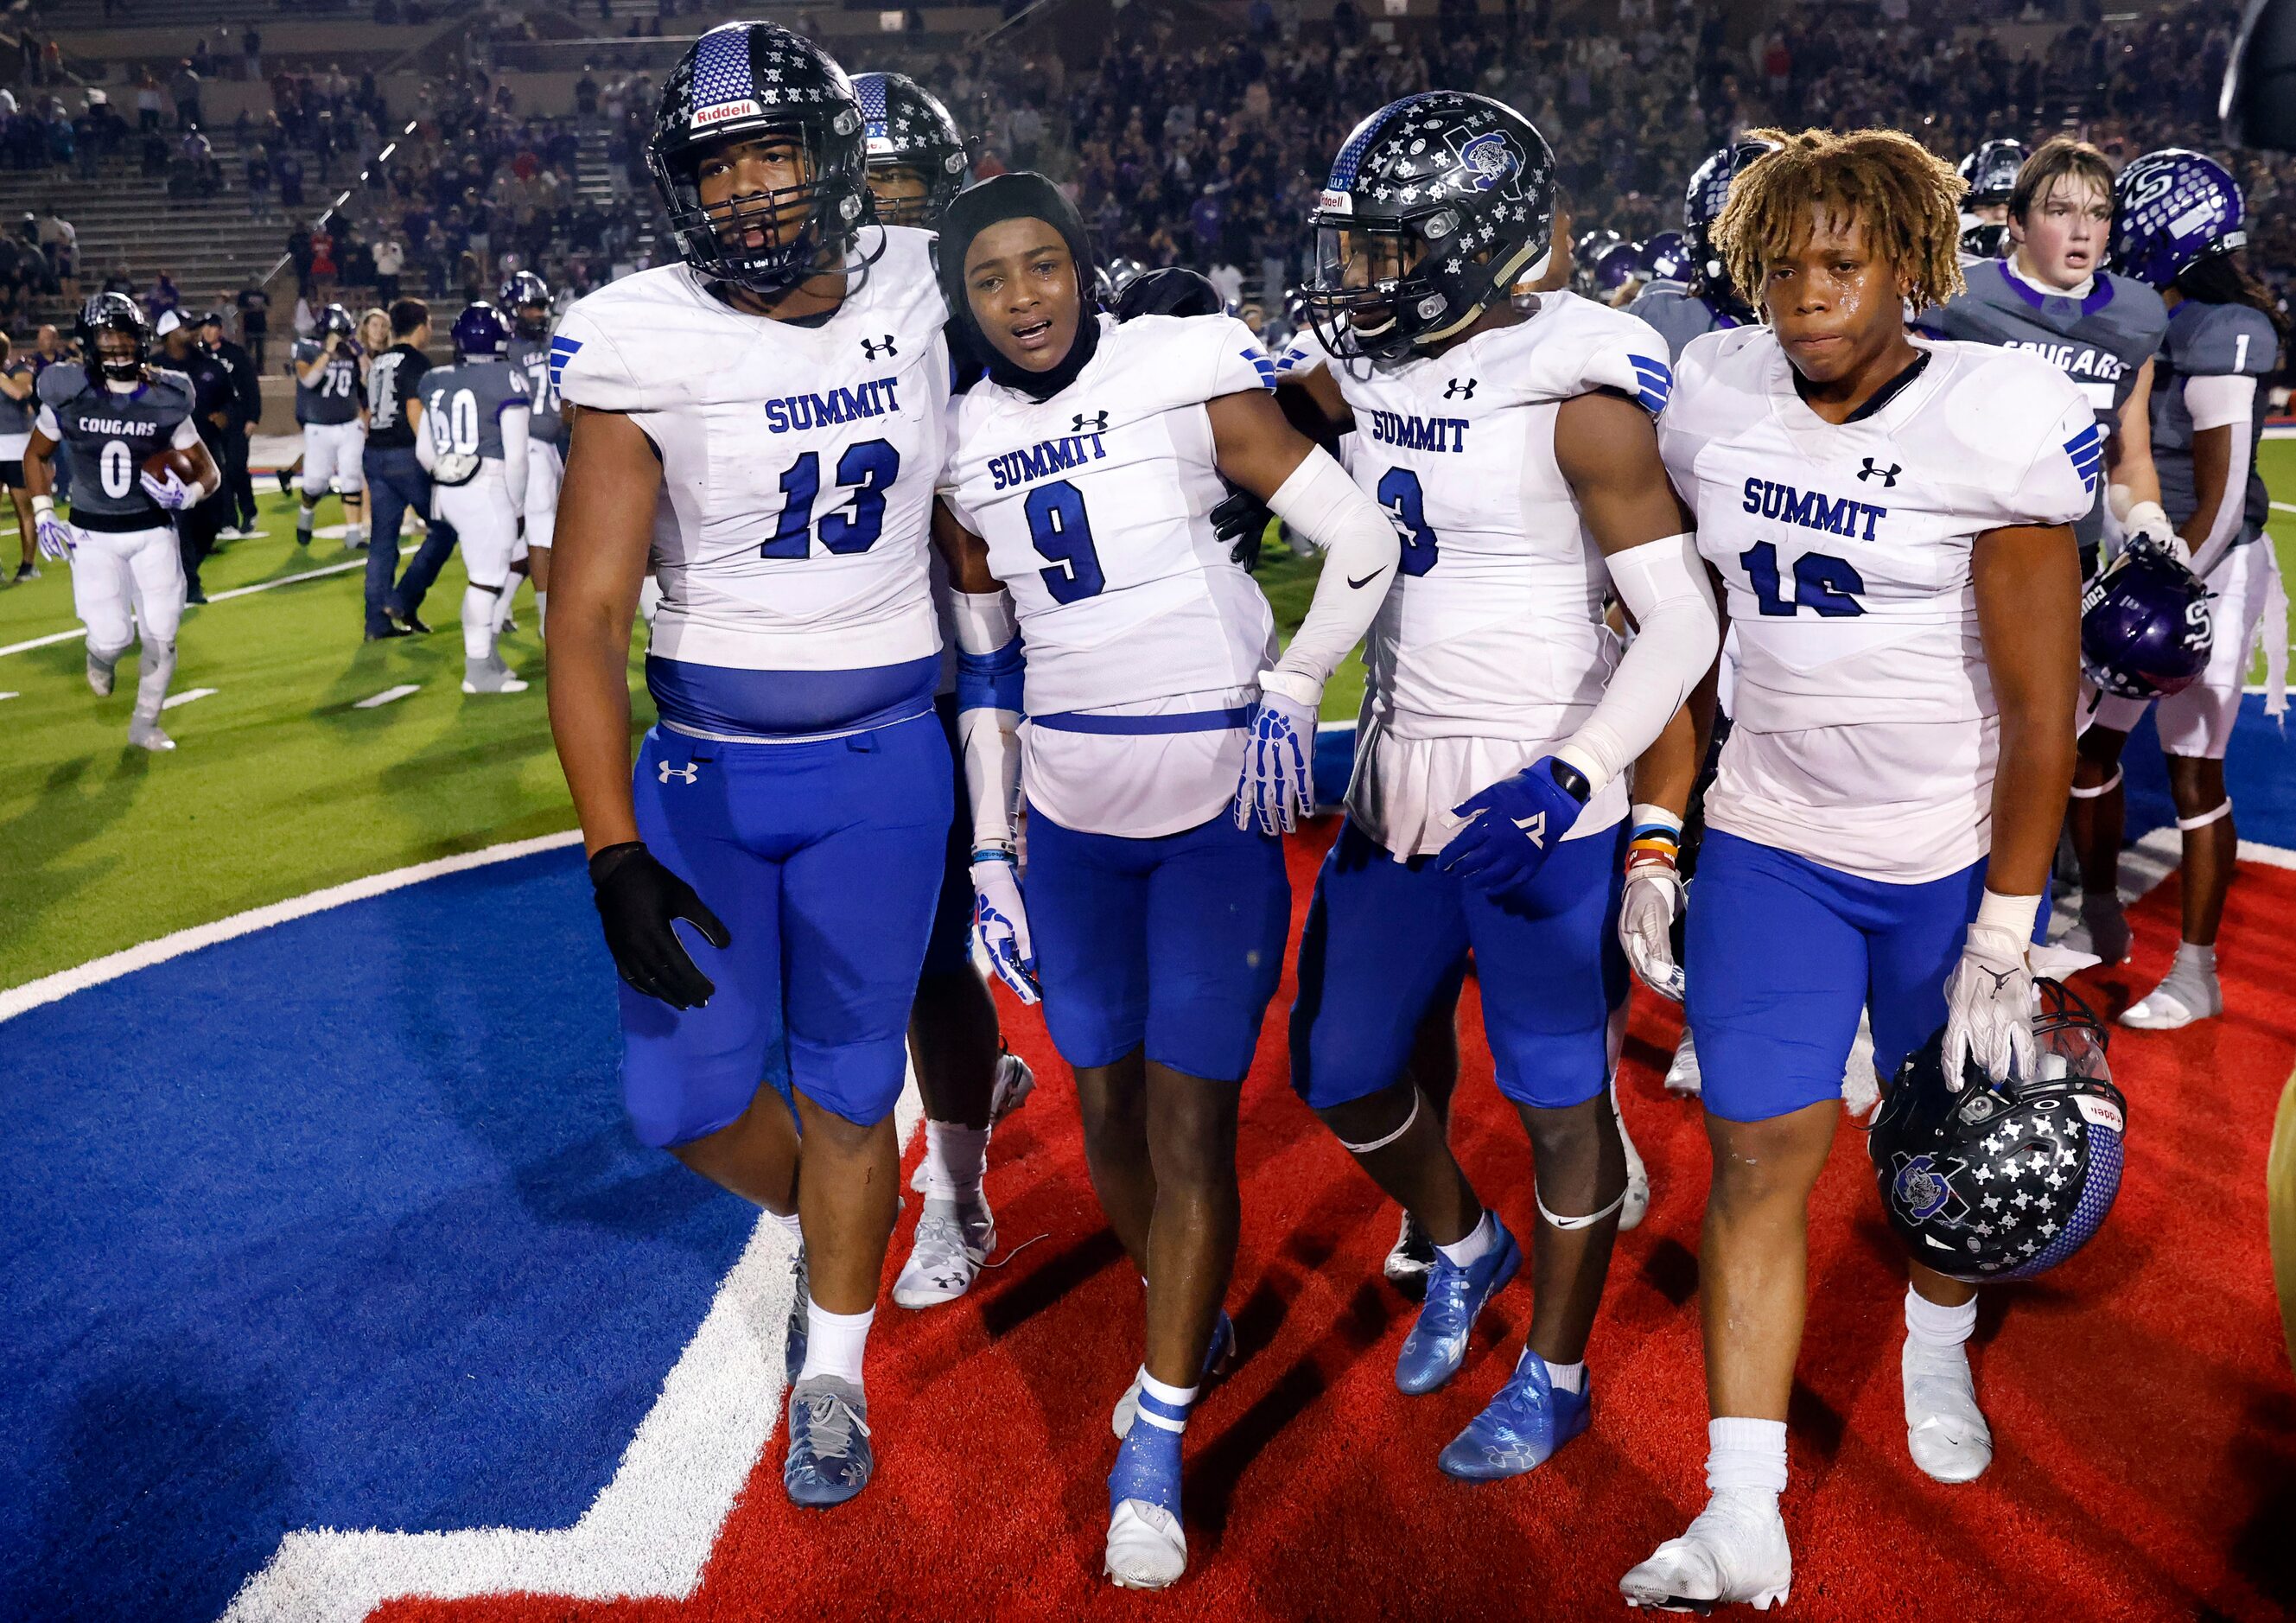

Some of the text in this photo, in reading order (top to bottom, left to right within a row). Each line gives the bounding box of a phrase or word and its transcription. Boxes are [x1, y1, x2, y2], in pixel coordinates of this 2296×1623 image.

[321, 367, 352, 398] 70
[2002, 341, 2132, 381] UGARS
[2234, 334, 2251, 373] 1
[79, 416, 157, 436] COUGARS
[429, 388, 480, 455] 60
[764, 376, 900, 434] SUMMIT
[1371, 409, 1470, 453] SUMMIT
[100, 439, 132, 500] 0
[987, 430, 1107, 491] SUMMIT
[760, 437, 900, 559] 13
[1377, 465, 1440, 577] 3
[1742, 476, 1887, 542] SUMMIT
[1023, 479, 1106, 606] 9
